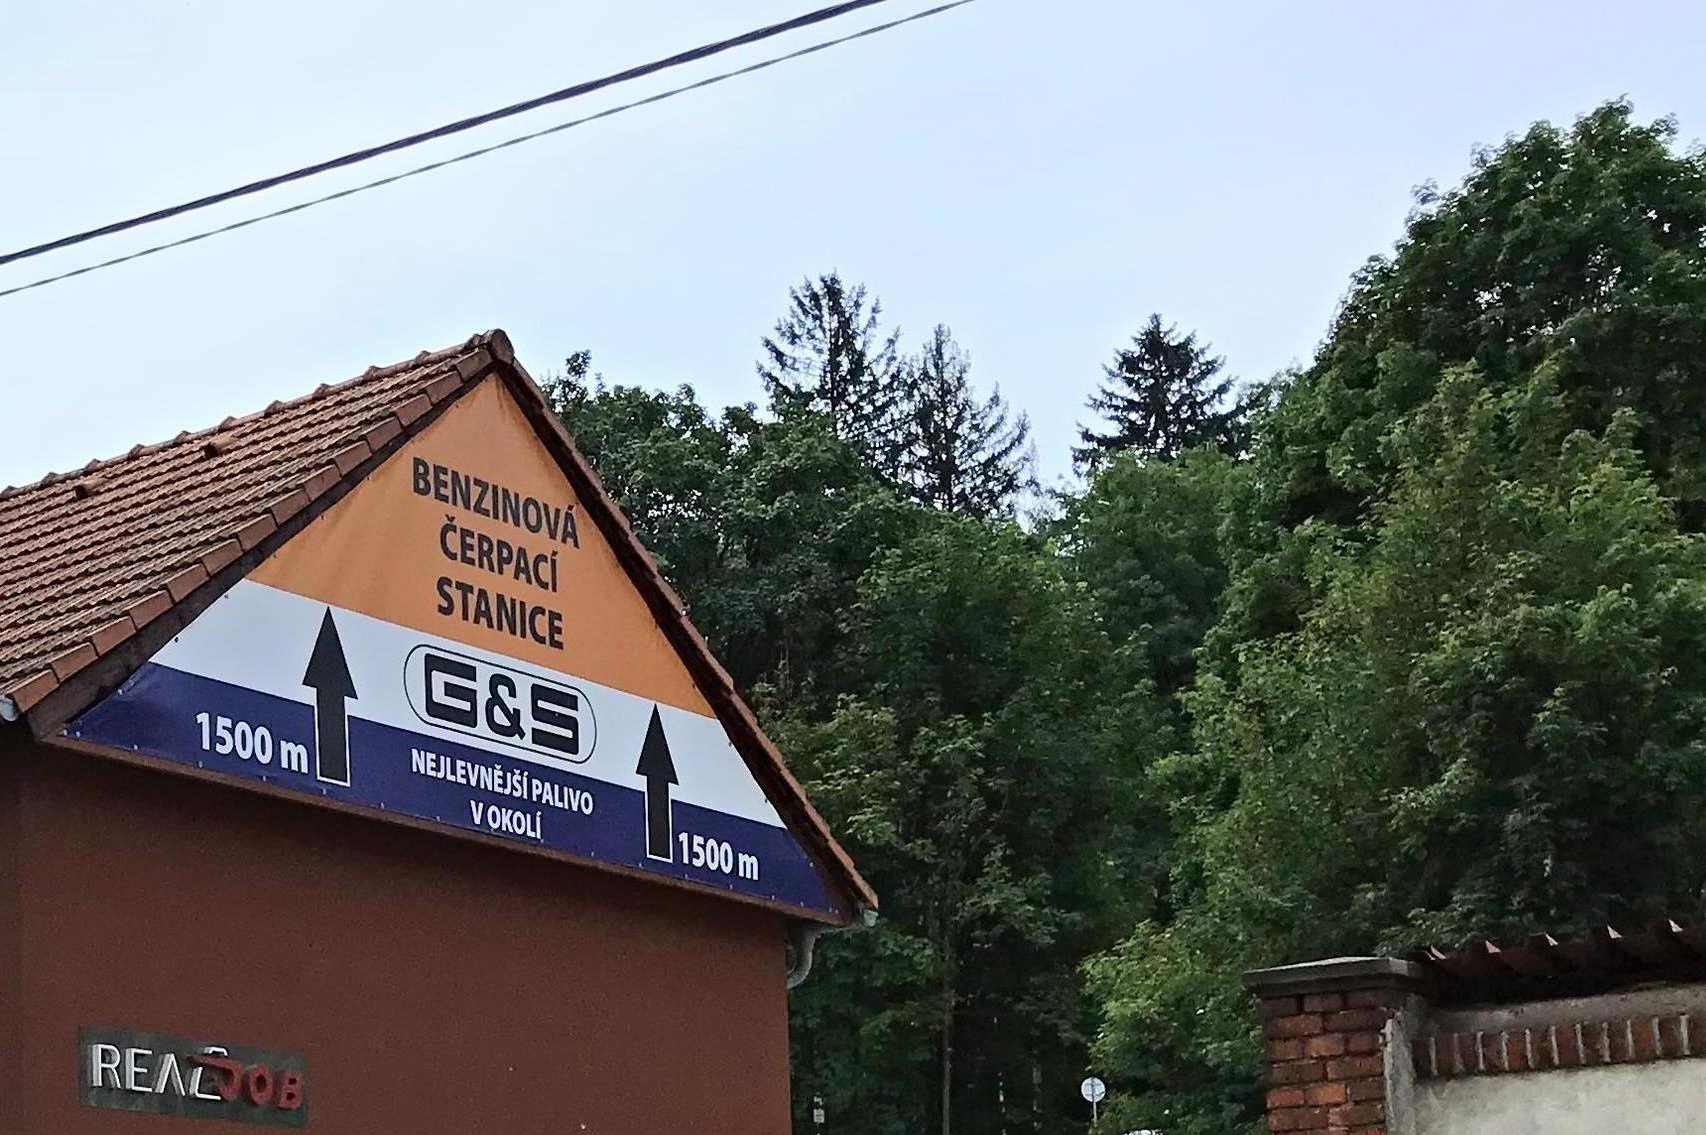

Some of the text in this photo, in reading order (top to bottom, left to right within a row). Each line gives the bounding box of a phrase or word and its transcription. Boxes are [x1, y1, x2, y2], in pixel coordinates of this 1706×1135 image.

[412, 456, 580, 549] BENZINOVÁ
[439, 513, 559, 593] ČERPACÍ
[435, 575, 564, 650] STANICE
[424, 652, 580, 756] G&S
[196, 711, 309, 774] 1500 m
[410, 747, 594, 816] NEJLEVNĚJŠÍ PALIVO
[469, 799, 543, 840] V OKOLÍ
[678, 831, 759, 881] 1500 m
